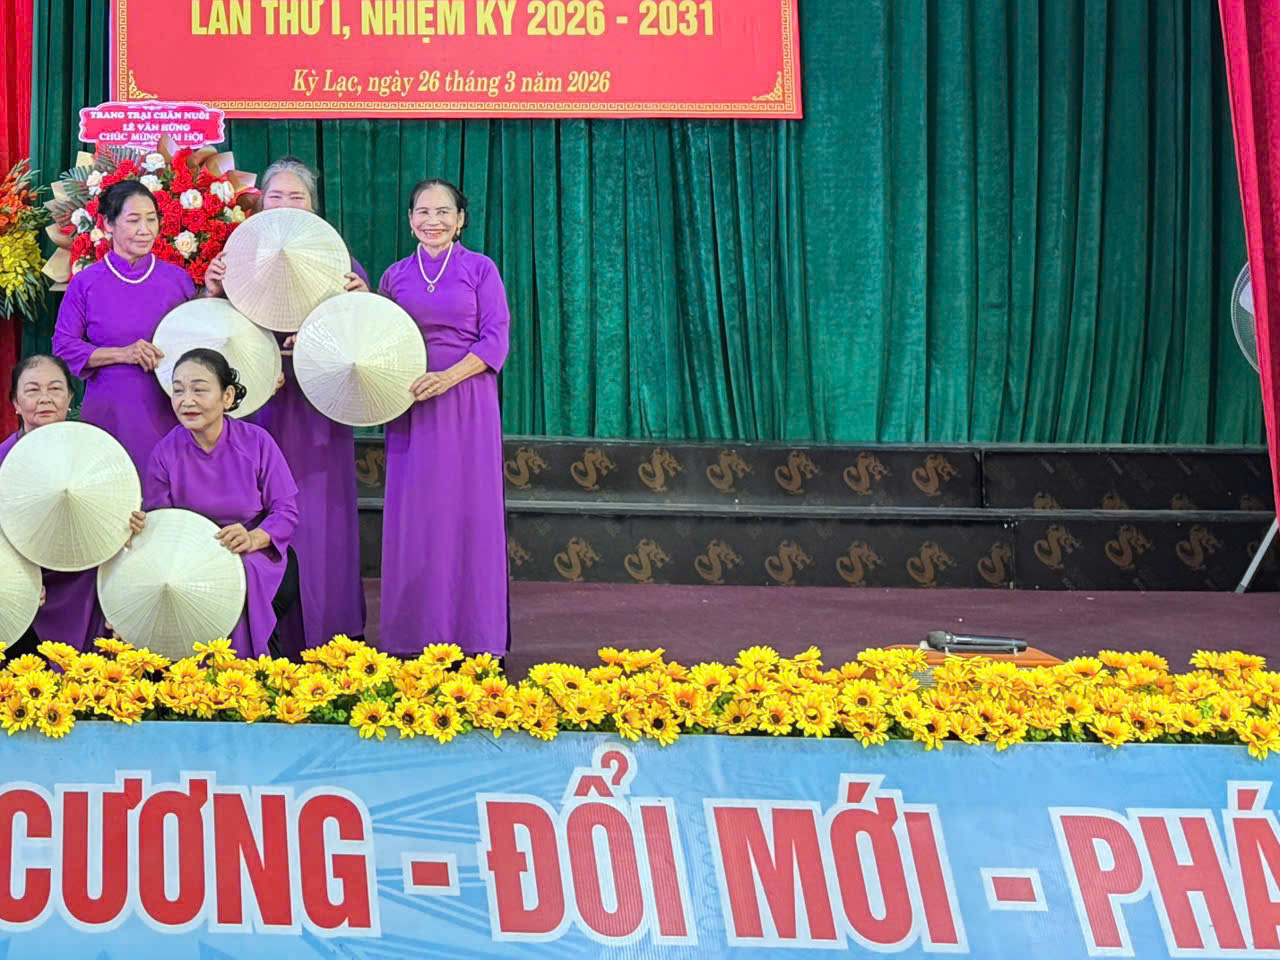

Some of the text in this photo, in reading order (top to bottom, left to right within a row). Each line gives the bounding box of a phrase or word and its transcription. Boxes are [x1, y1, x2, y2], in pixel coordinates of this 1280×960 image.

[331, 0, 351, 40] I,
[527, 0, 606, 37] 2026
[616, 15, 629, 25] -
[639, 0, 714, 37] 2031
[292, 68, 612, 98] Kỳ Lạc, ngày 26 tháng 3 năm 2026
[90, 111, 125, 119] TRANG
[127, 111, 152, 120] TRẠI
[409, 861, 451, 888] -
[486, 749, 687, 936] ĐỔI
[712, 782, 958, 945] MỚI
[992, 876, 1035, 902] -
